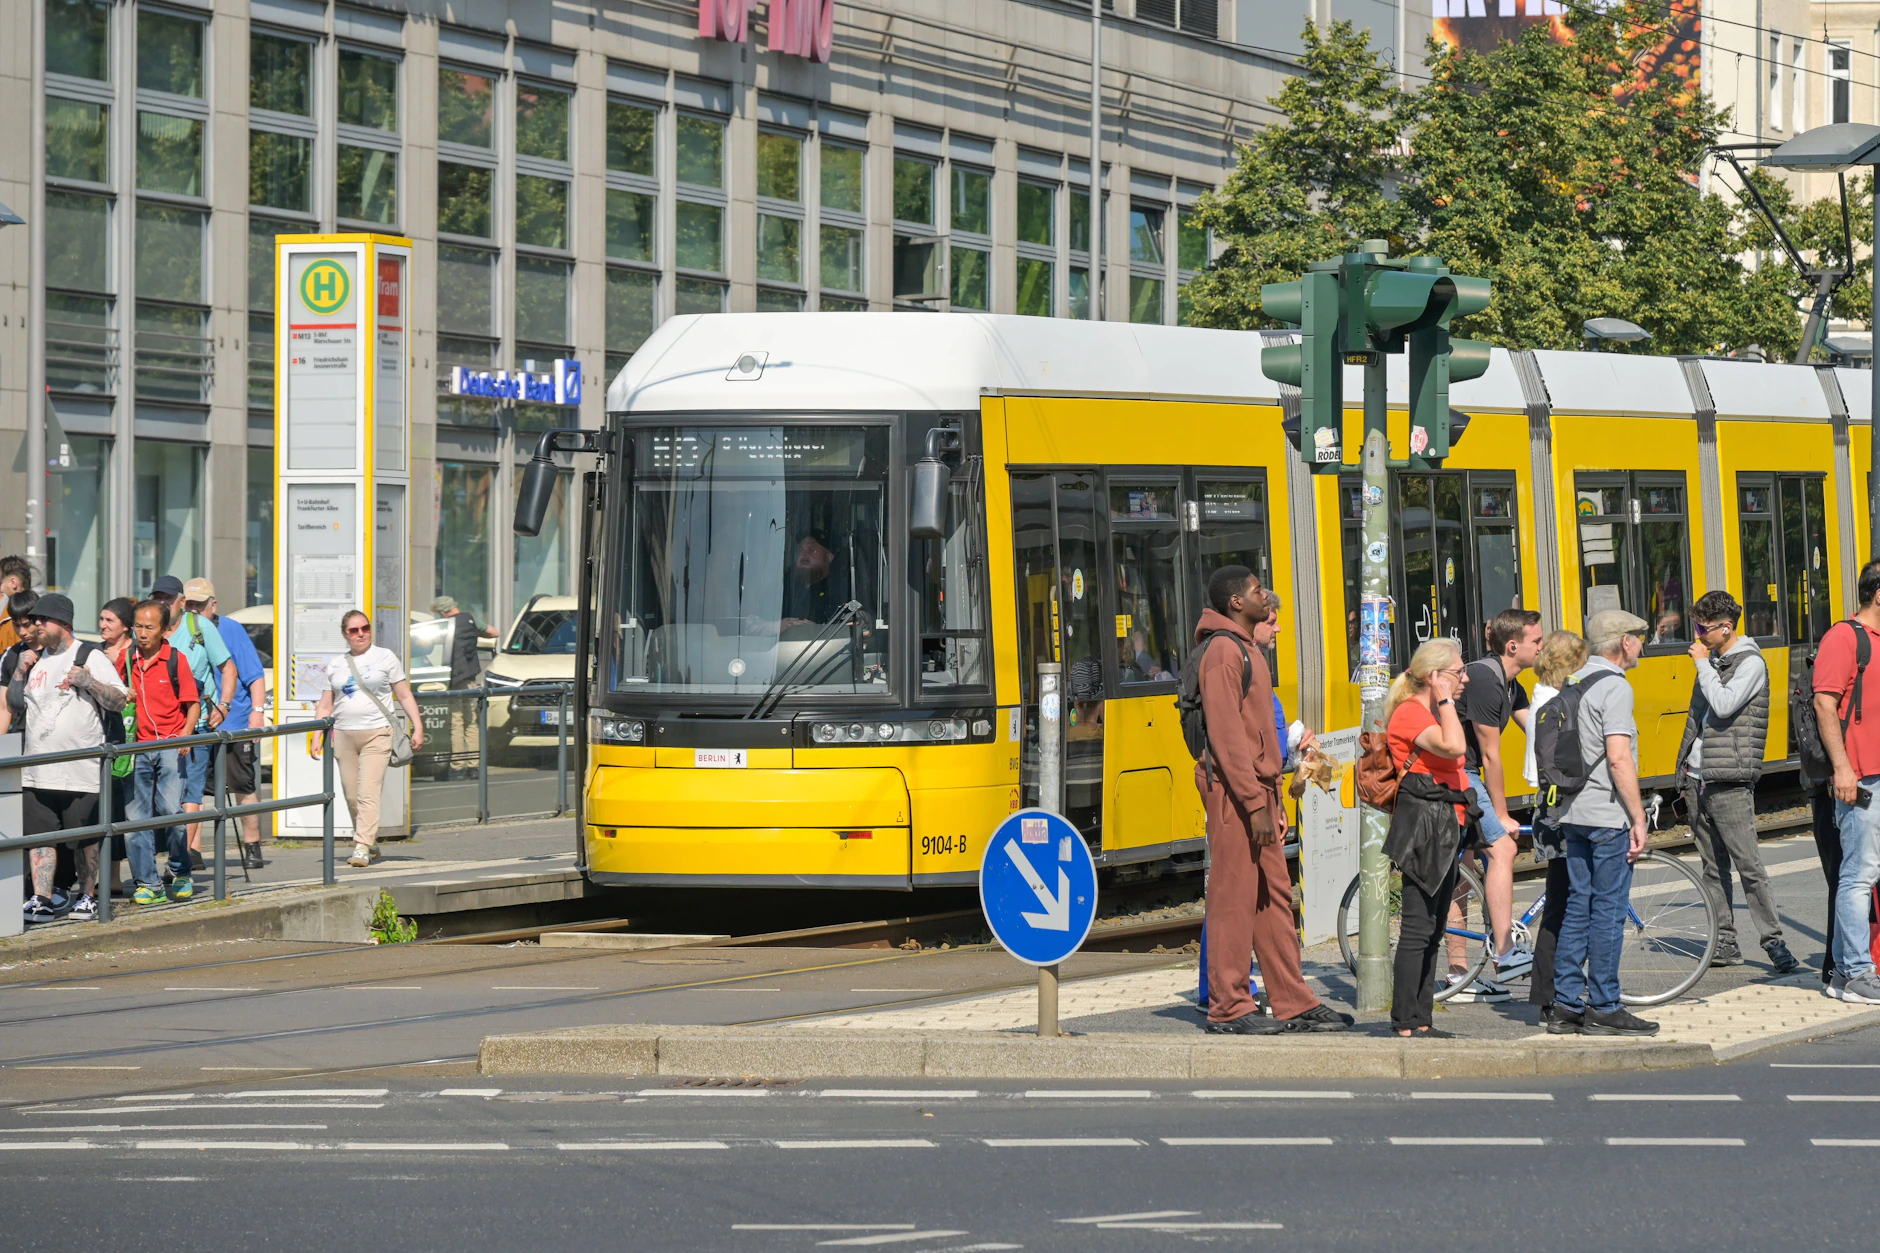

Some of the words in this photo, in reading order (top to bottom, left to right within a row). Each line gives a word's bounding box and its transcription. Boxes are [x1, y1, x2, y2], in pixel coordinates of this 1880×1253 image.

[313, 271, 336, 301] H
[298, 332, 311, 340] M13
[453, 366, 520, 399] Deutsche
[698, 754, 726, 762] BERLIN
[921, 834, 967, 855] 9104-B
